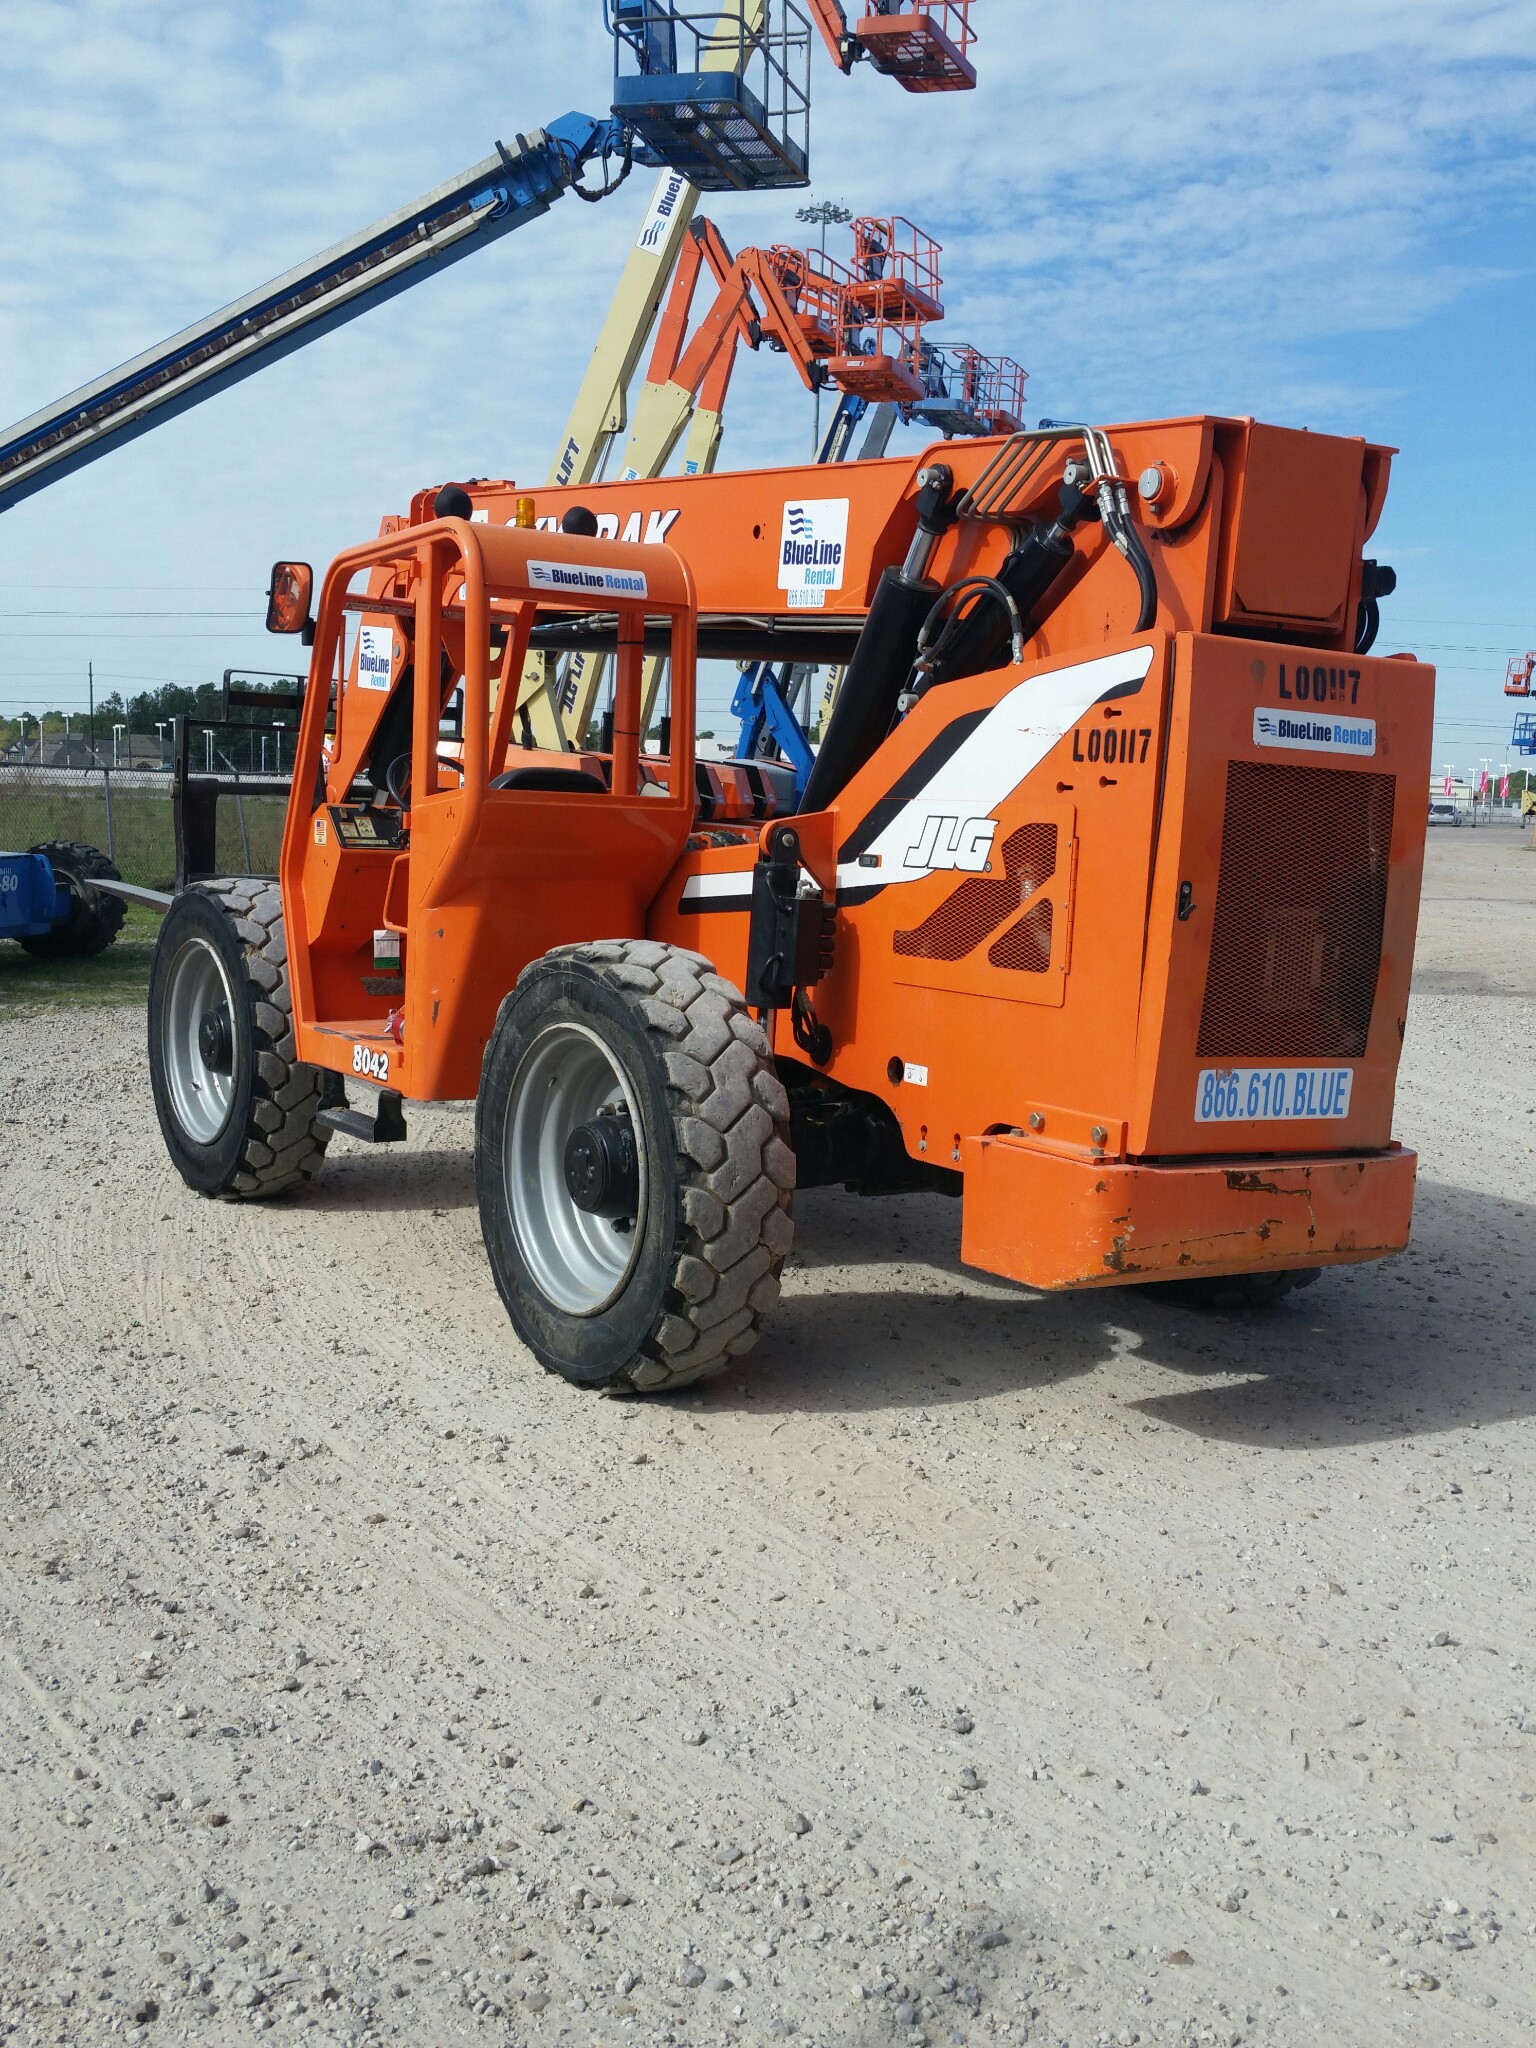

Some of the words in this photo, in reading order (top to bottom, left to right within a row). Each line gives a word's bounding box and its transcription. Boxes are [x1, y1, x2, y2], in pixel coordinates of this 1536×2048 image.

[657, 168, 684, 217] BlueL
[556, 436, 580, 486] LIFT
[783, 540, 842, 565] BlueLine
[552, 569, 604, 587] BlueLine
[605, 575, 644, 591] Rental
[804, 568, 835, 585] Rental
[360, 653, 390, 674] BlueLine
[371, 674, 387, 688] Rental
[563, 681, 579, 715] JLG
[571, 652, 586, 680] LIF
[823, 681, 834, 705] JLG
[1278, 719, 1332, 742] BlueLine
[1333, 725, 1373, 746] Rental
[903, 815, 1000, 873] JLG
[352, 1044, 389, 1082] 8042
[1202, 1072, 1348, 1118] 866.610.BLUE
